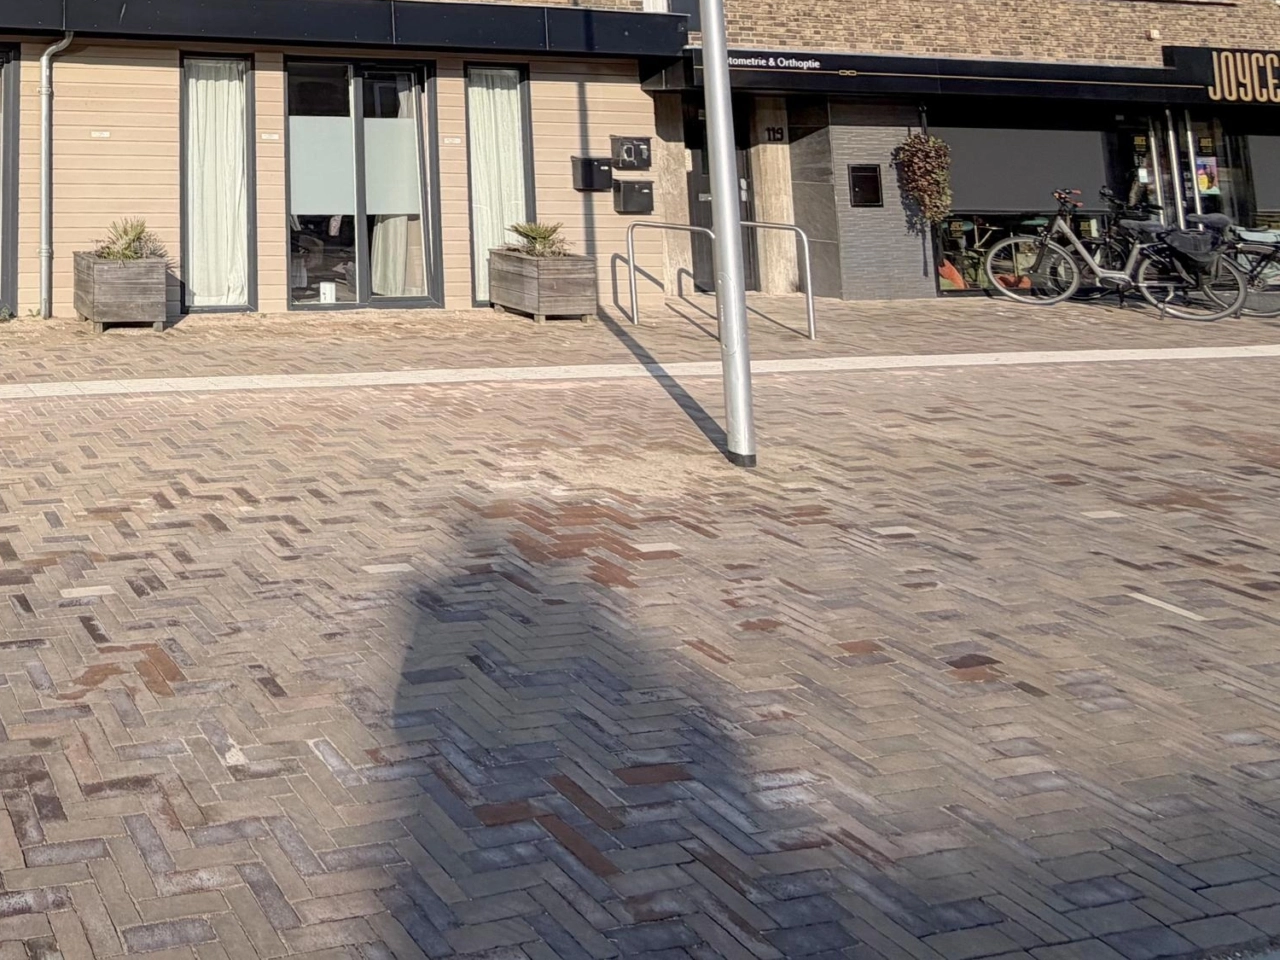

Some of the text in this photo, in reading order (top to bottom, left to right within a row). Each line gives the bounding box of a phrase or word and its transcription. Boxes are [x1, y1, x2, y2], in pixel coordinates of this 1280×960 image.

[726, 56, 821, 70] tometrie & Orthoptie
[1208, 50, 1280, 103] JOYCE
[765, 126, 784, 142] 119
